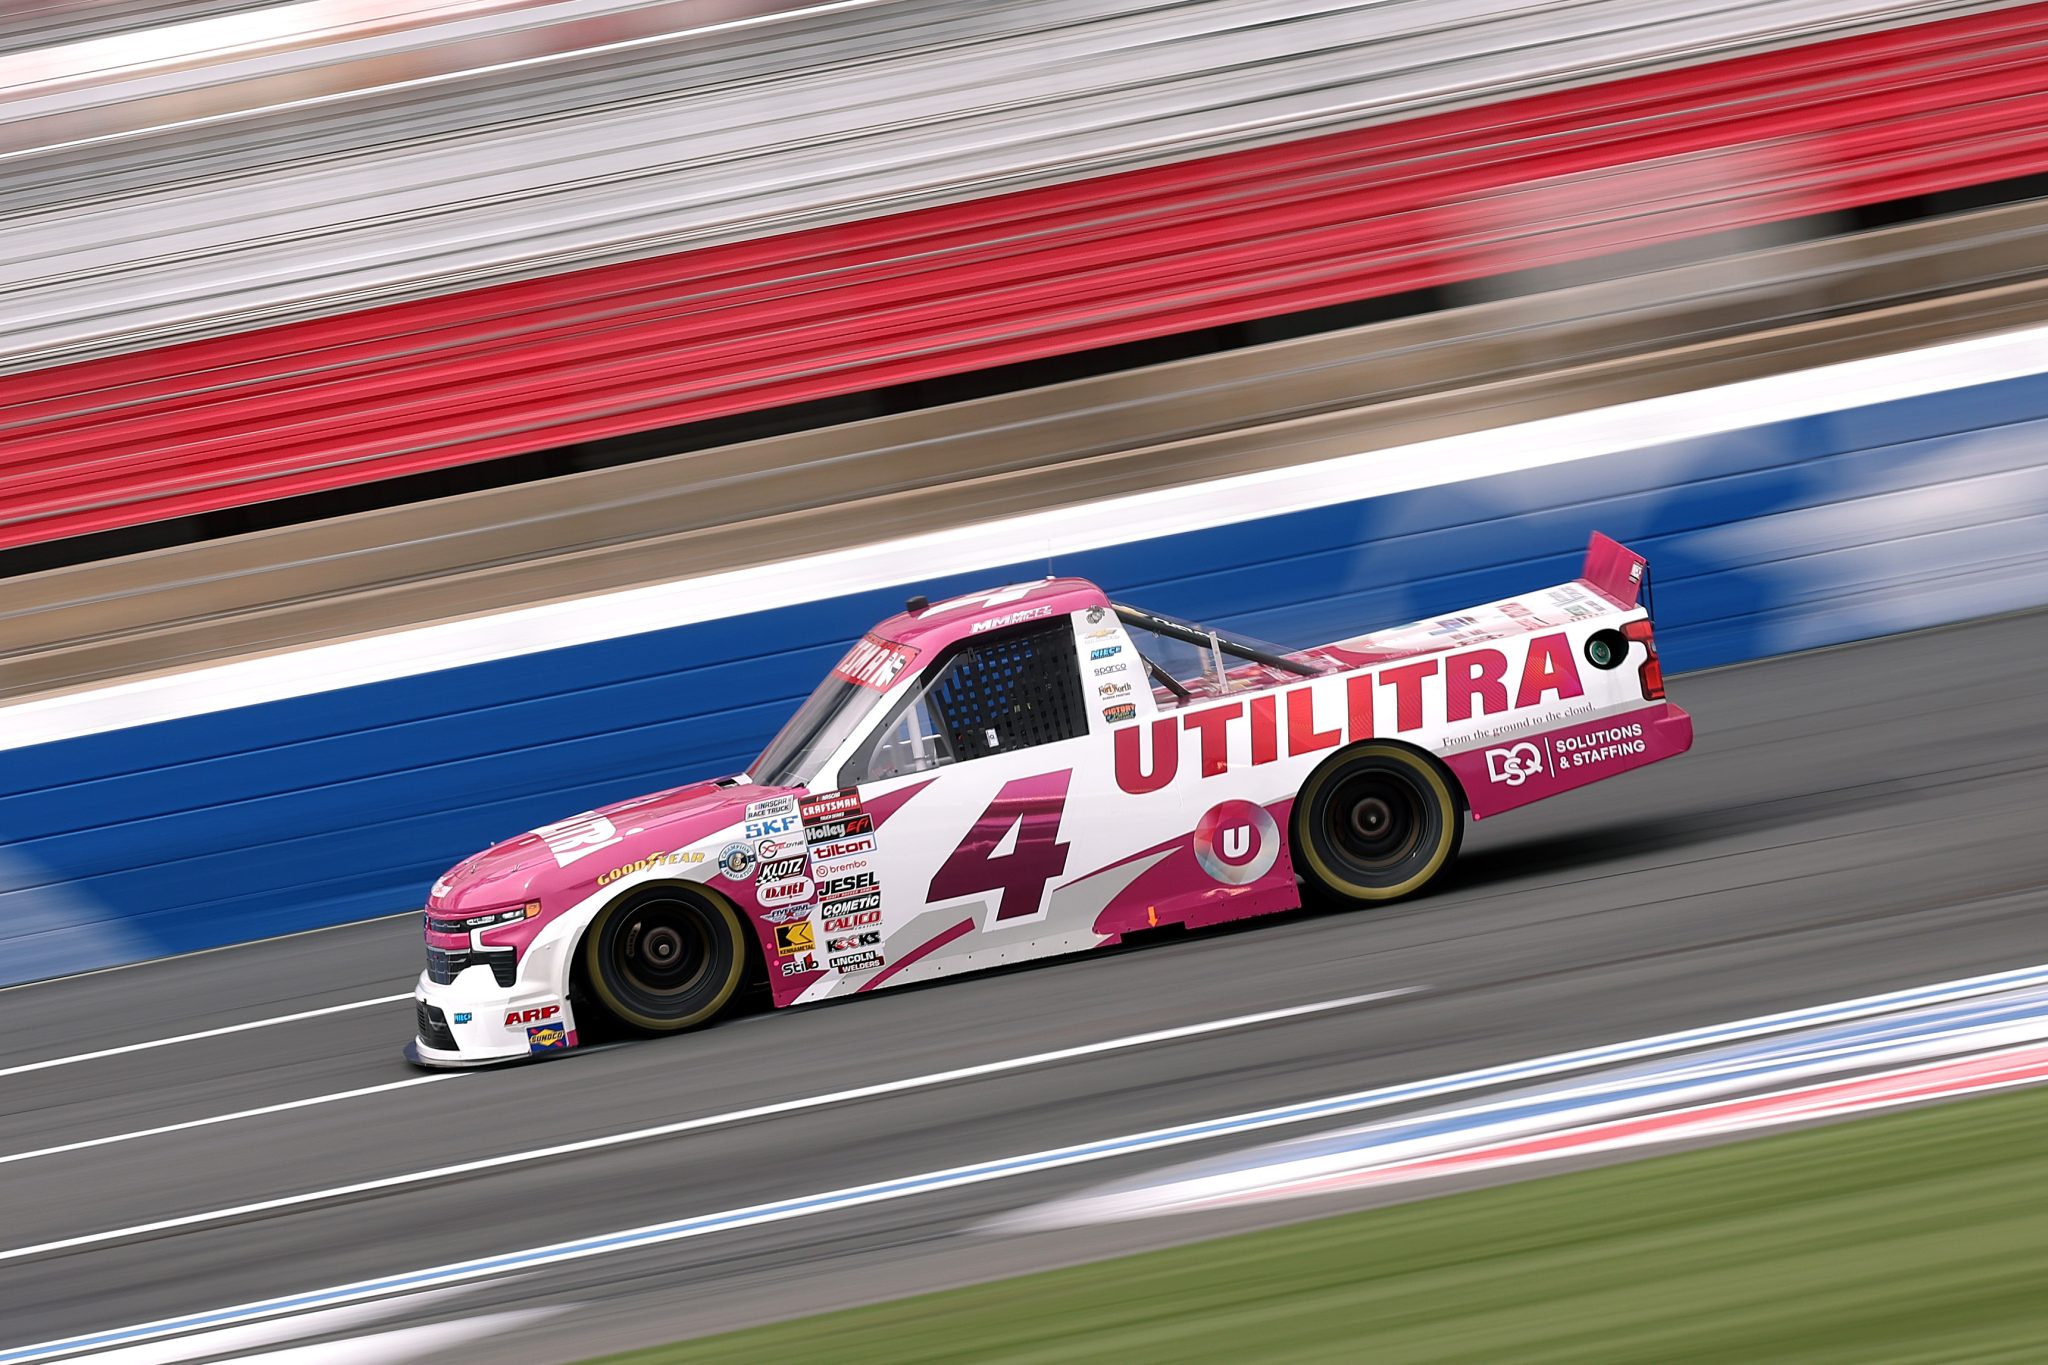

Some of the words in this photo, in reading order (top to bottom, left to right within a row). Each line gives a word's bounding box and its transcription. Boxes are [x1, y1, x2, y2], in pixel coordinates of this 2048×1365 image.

[1094, 663, 1127, 675] sparco
[1103, 703, 1136, 715] VICTORY
[1114, 632, 1584, 794] UTILITRA
[1442, 734, 1471, 747] From
[1474, 730, 1491, 739] the
[1493, 718, 1530, 737] ground
[1533, 716, 1543, 725] to
[1546, 711, 1563, 722] the
[1556, 723, 1642, 752] SOLUTIONS
[1559, 757, 1570, 769] &
[1573, 739, 1646, 766] STAFFING
[748, 809, 767, 819] RACE
[768, 804, 789, 814] TRUCK
[803, 797, 858, 816] CRAFTSMAN
[745, 815, 798, 839] SKF
[807, 826, 845, 841] Holley
[814, 840, 871, 859] tilton
[926, 767, 1073, 921] 4
[1223, 824, 1250, 858] U
[596, 851, 705, 886] GOODYEAR
[762, 858, 801, 878] KLOTZ
[829, 860, 867, 873] brembo
[819, 872, 880, 896] JESEL
[823, 895, 880, 916] COMETIC
[824, 911, 881, 933] CALICO
[827, 932, 881, 952] KOOKS
[831, 952, 874, 968] LINCOLN
[842, 960, 881, 973] WELDERS
[504, 1005, 561, 1026] ARP
[530, 1031, 564, 1044] SUNOCO
